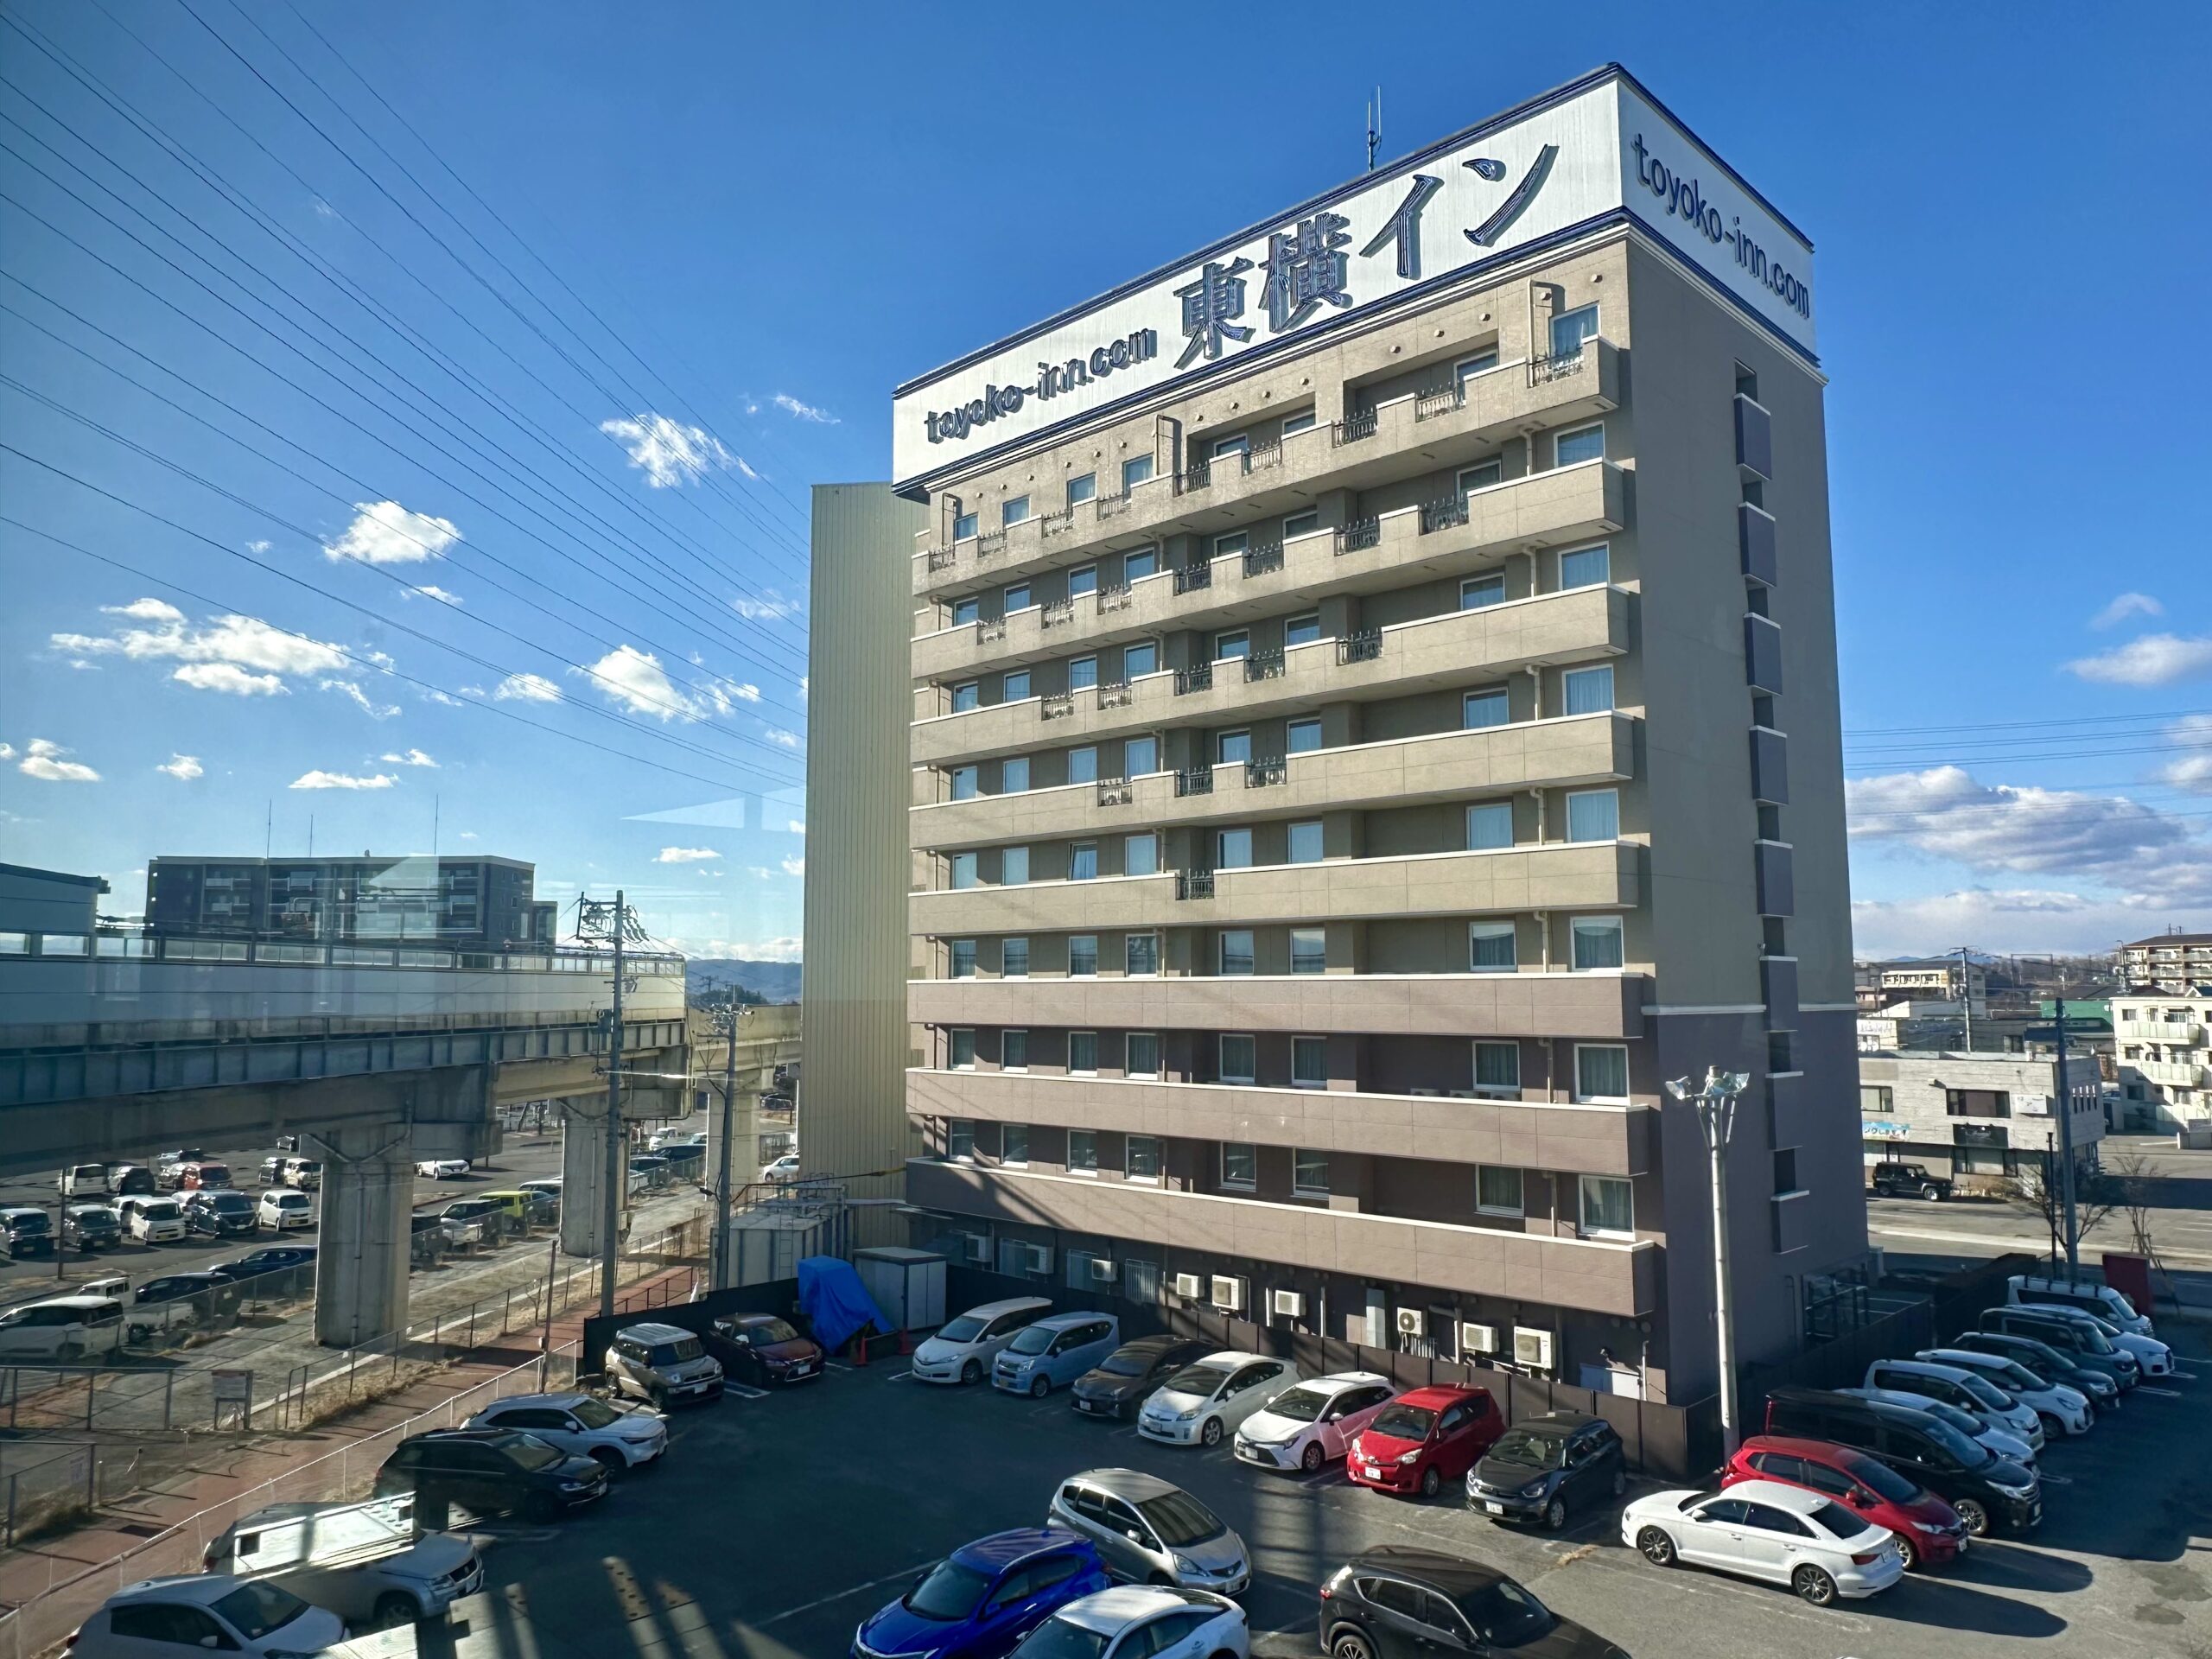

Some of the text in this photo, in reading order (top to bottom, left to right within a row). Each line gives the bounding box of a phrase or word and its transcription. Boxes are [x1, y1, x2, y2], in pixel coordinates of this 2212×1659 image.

[1173, 143, 1559, 370] 東横イン
[1631, 133, 1810, 319] toyoko-inn.com
[924, 327, 1157, 444] toyoko-inn.com
